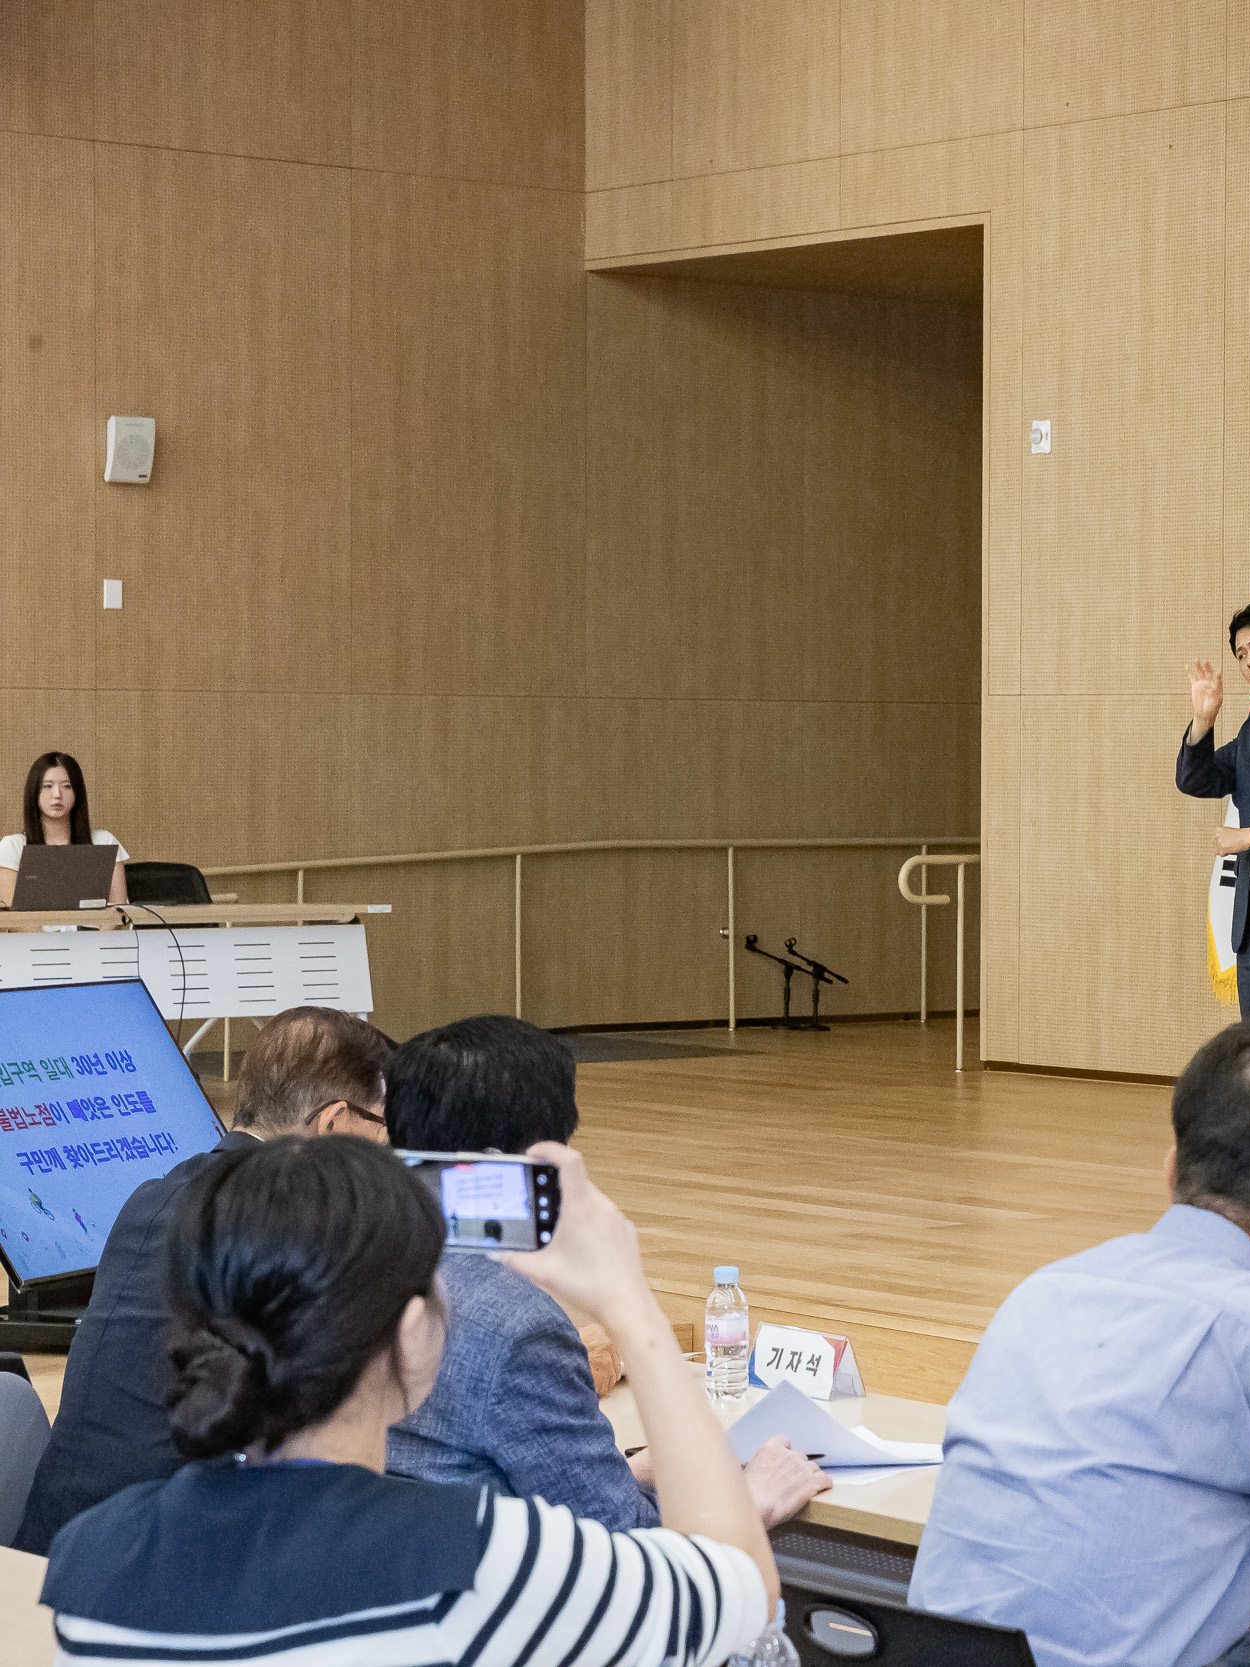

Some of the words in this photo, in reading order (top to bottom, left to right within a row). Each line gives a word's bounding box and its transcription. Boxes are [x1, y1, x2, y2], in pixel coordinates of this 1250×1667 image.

[40, 1056, 75, 1081] 일대
[71, 1053, 108, 1075] 30년
[105, 1050, 136, 1073] 이상
[111, 1091, 156, 1116] 인도를
[16, 1147, 67, 1175] 구민께
[62, 1132, 178, 1169] 찾아드리겠습니다!
[766, 1347, 822, 1377] 기자석
